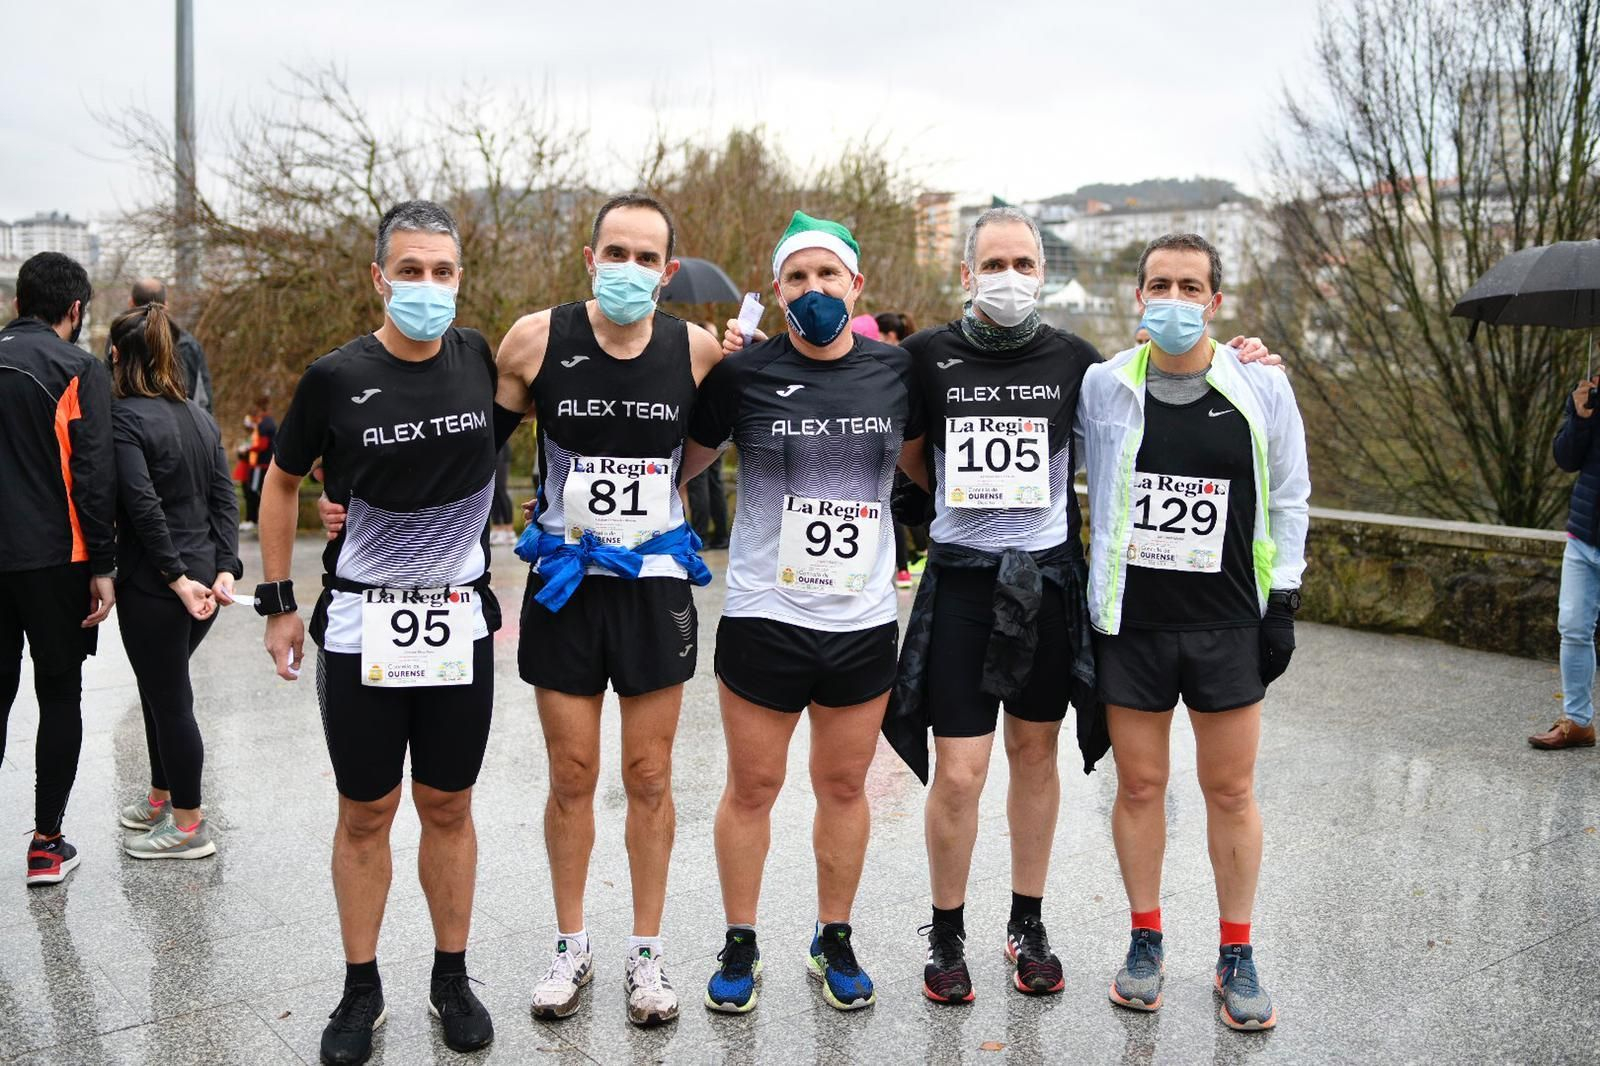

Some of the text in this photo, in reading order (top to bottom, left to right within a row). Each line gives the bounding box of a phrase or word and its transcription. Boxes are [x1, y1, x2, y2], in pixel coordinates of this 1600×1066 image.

[946, 385, 1060, 404] ALEX TEAM
[557, 399, 680, 421] ALEX TEAM
[362, 410, 487, 447] ALEX TEAM
[771, 417, 893, 436] ALEX TEAM
[949, 418, 975, 433] La
[957, 437, 1041, 473] 105
[572, 457, 595, 474] La
[1133, 478, 1152, 490] a
[588, 479, 648, 516] 81
[786, 496, 813, 514] La
[968, 492, 1003, 500] OURENSE
[1133, 494, 1218, 536] 129
[805, 520, 859, 559] 93
[1140, 551, 1175, 562] OURENSE
[798, 575, 833, 586] OURENSE
[366, 590, 395, 604] La
[390, 609, 451, 648] 95
[387, 670, 425, 678] OURENSE
